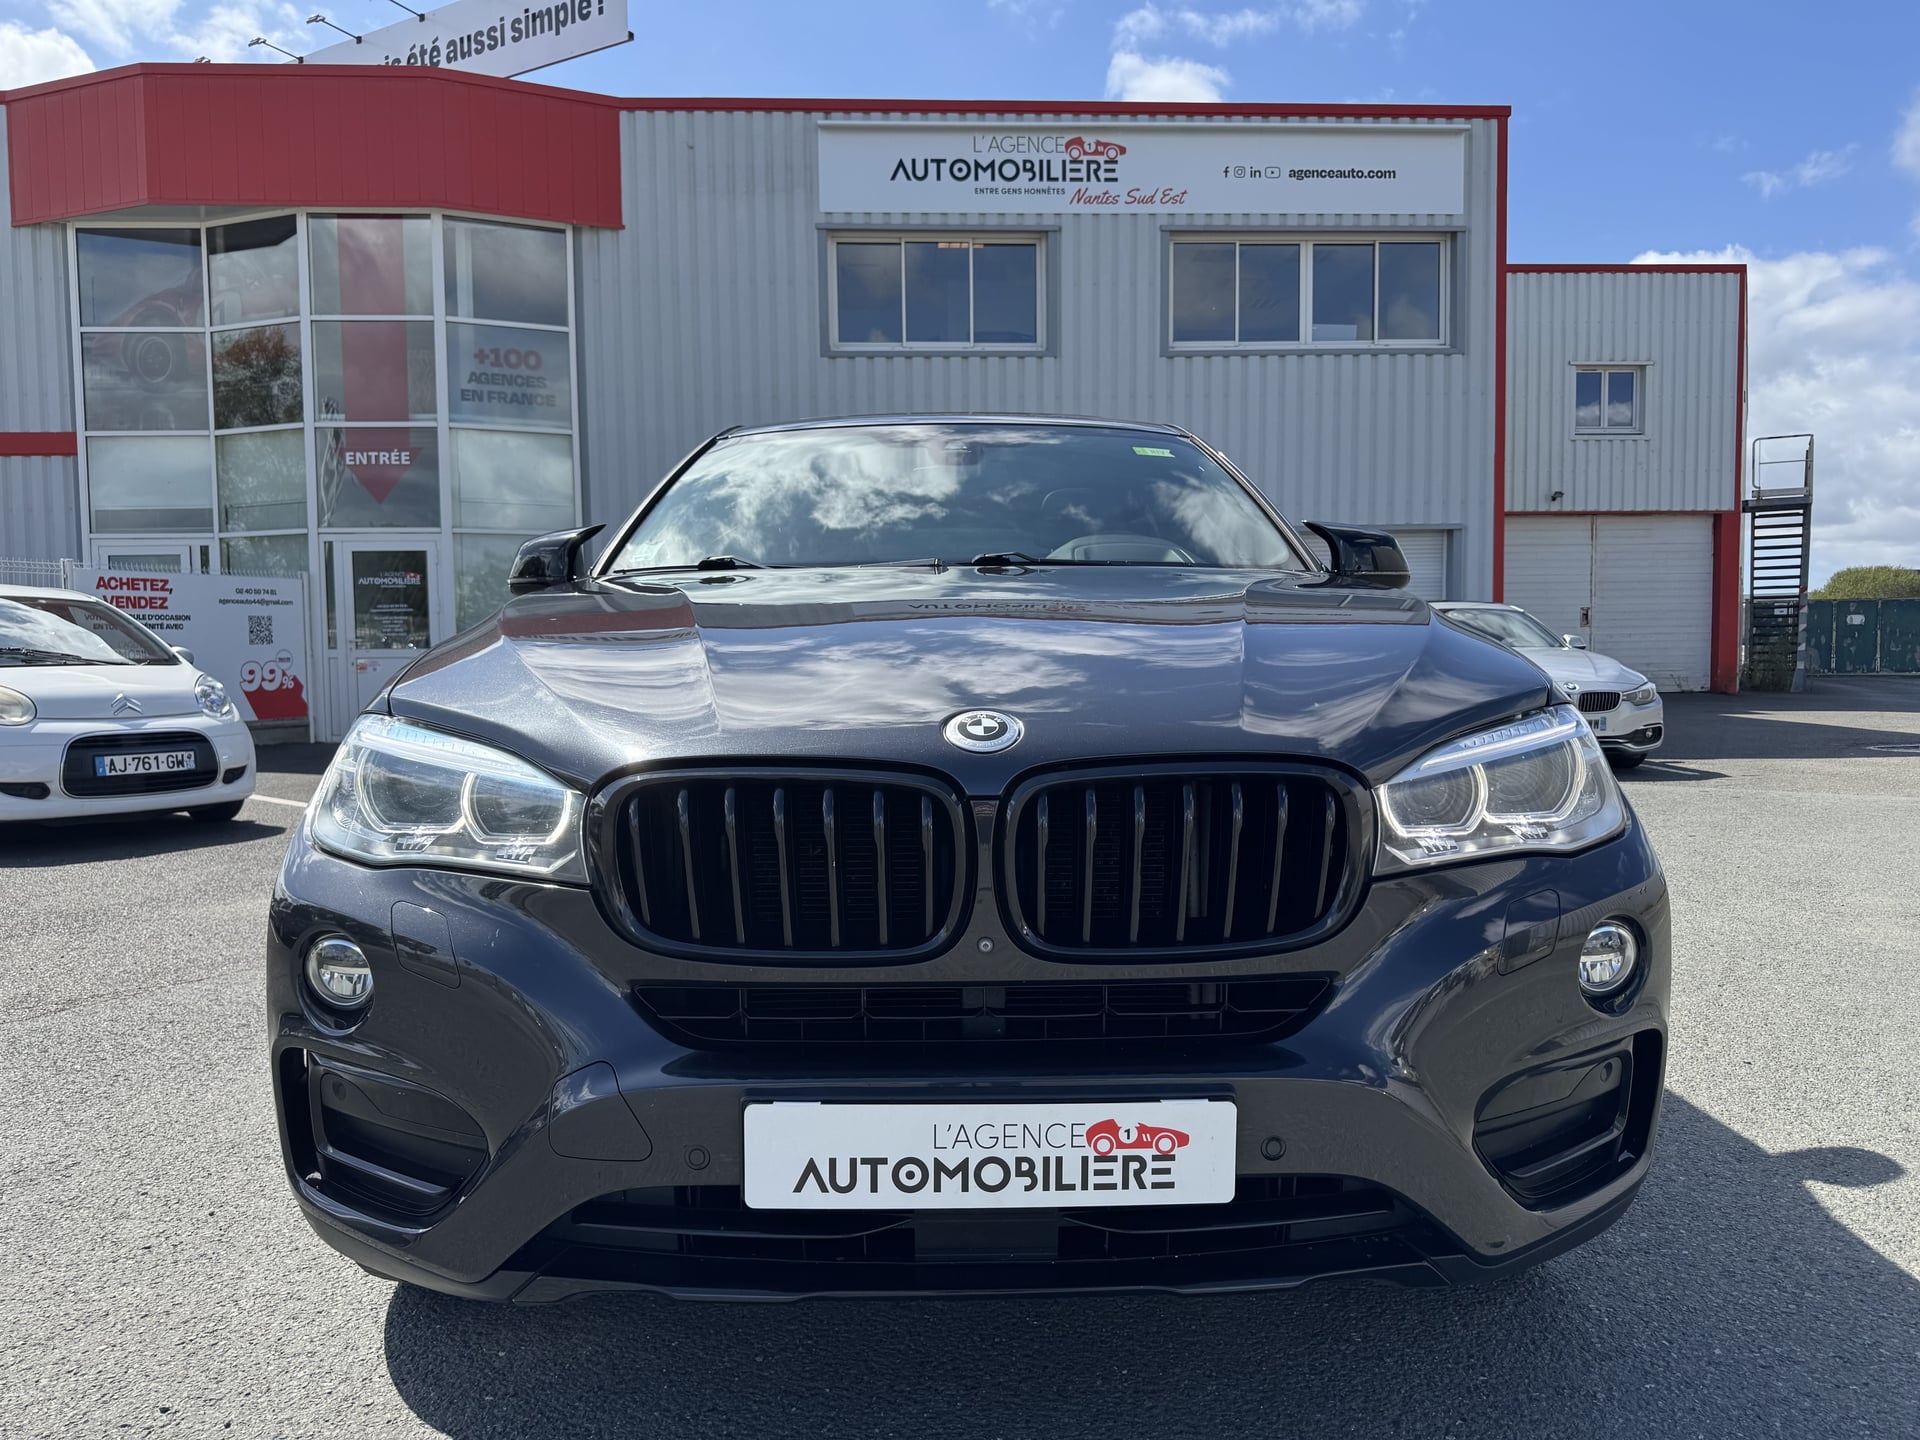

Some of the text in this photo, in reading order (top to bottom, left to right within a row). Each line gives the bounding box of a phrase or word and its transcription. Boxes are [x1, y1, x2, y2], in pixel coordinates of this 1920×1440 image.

[407, 37, 441, 66] été
[446, 17, 506, 64] aussi
[973, 135, 1064, 153] L'AGENCE
[1288, 168, 1397, 181] agenceauto.com
[974, 185, 1066, 195] ENTRE GENS HONNÊTES
[1069, 187, 1188, 206] Nantes Sud Est
[473, 347, 543, 371] +100
[467, 371, 547, 388] AGENCES
[460, 389, 556, 407] EN FRANCE
[345, 449, 411, 465] ENTRÉE
[95, 576, 173, 594] ACHETEZ,
[102, 595, 168, 609] VENDEZ
[933, 1122, 1087, 1149] L'AGENCE
